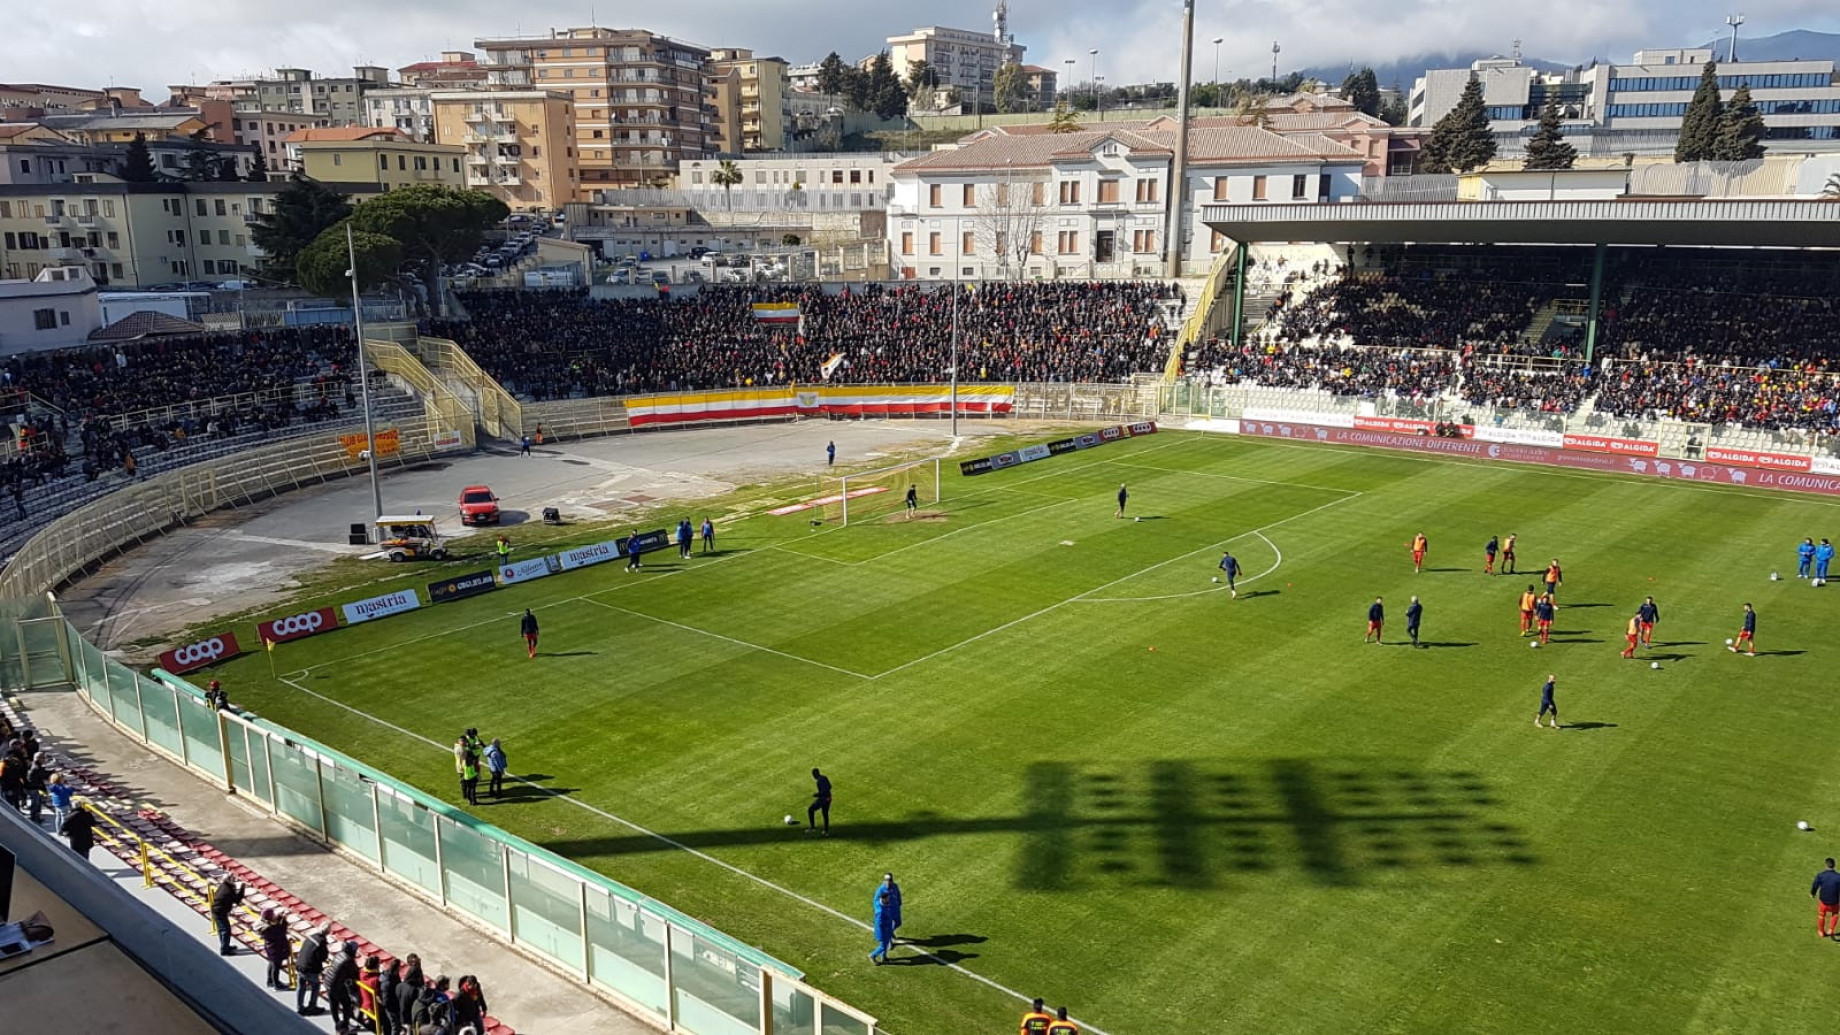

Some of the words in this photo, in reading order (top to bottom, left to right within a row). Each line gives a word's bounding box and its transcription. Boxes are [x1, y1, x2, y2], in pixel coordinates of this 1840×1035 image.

[1336, 431, 1347, 439] LA
[1350, 432, 1424, 447] COMUNICAZIONE
[1427, 438, 1481, 453] DIFFERENTE
[1577, 440, 1604, 448] ALGIDA
[1624, 444, 1653, 452] ALGIDA
[1722, 451, 1754, 462] ALGIDA
[1772, 458, 1807, 467] ALGIDA
[1759, 473, 1773, 483] LA
[569, 544, 609, 562] mastria
[355, 593, 407, 615] mastria
[272, 611, 322, 636] coop
[174, 638, 224, 665] coop
